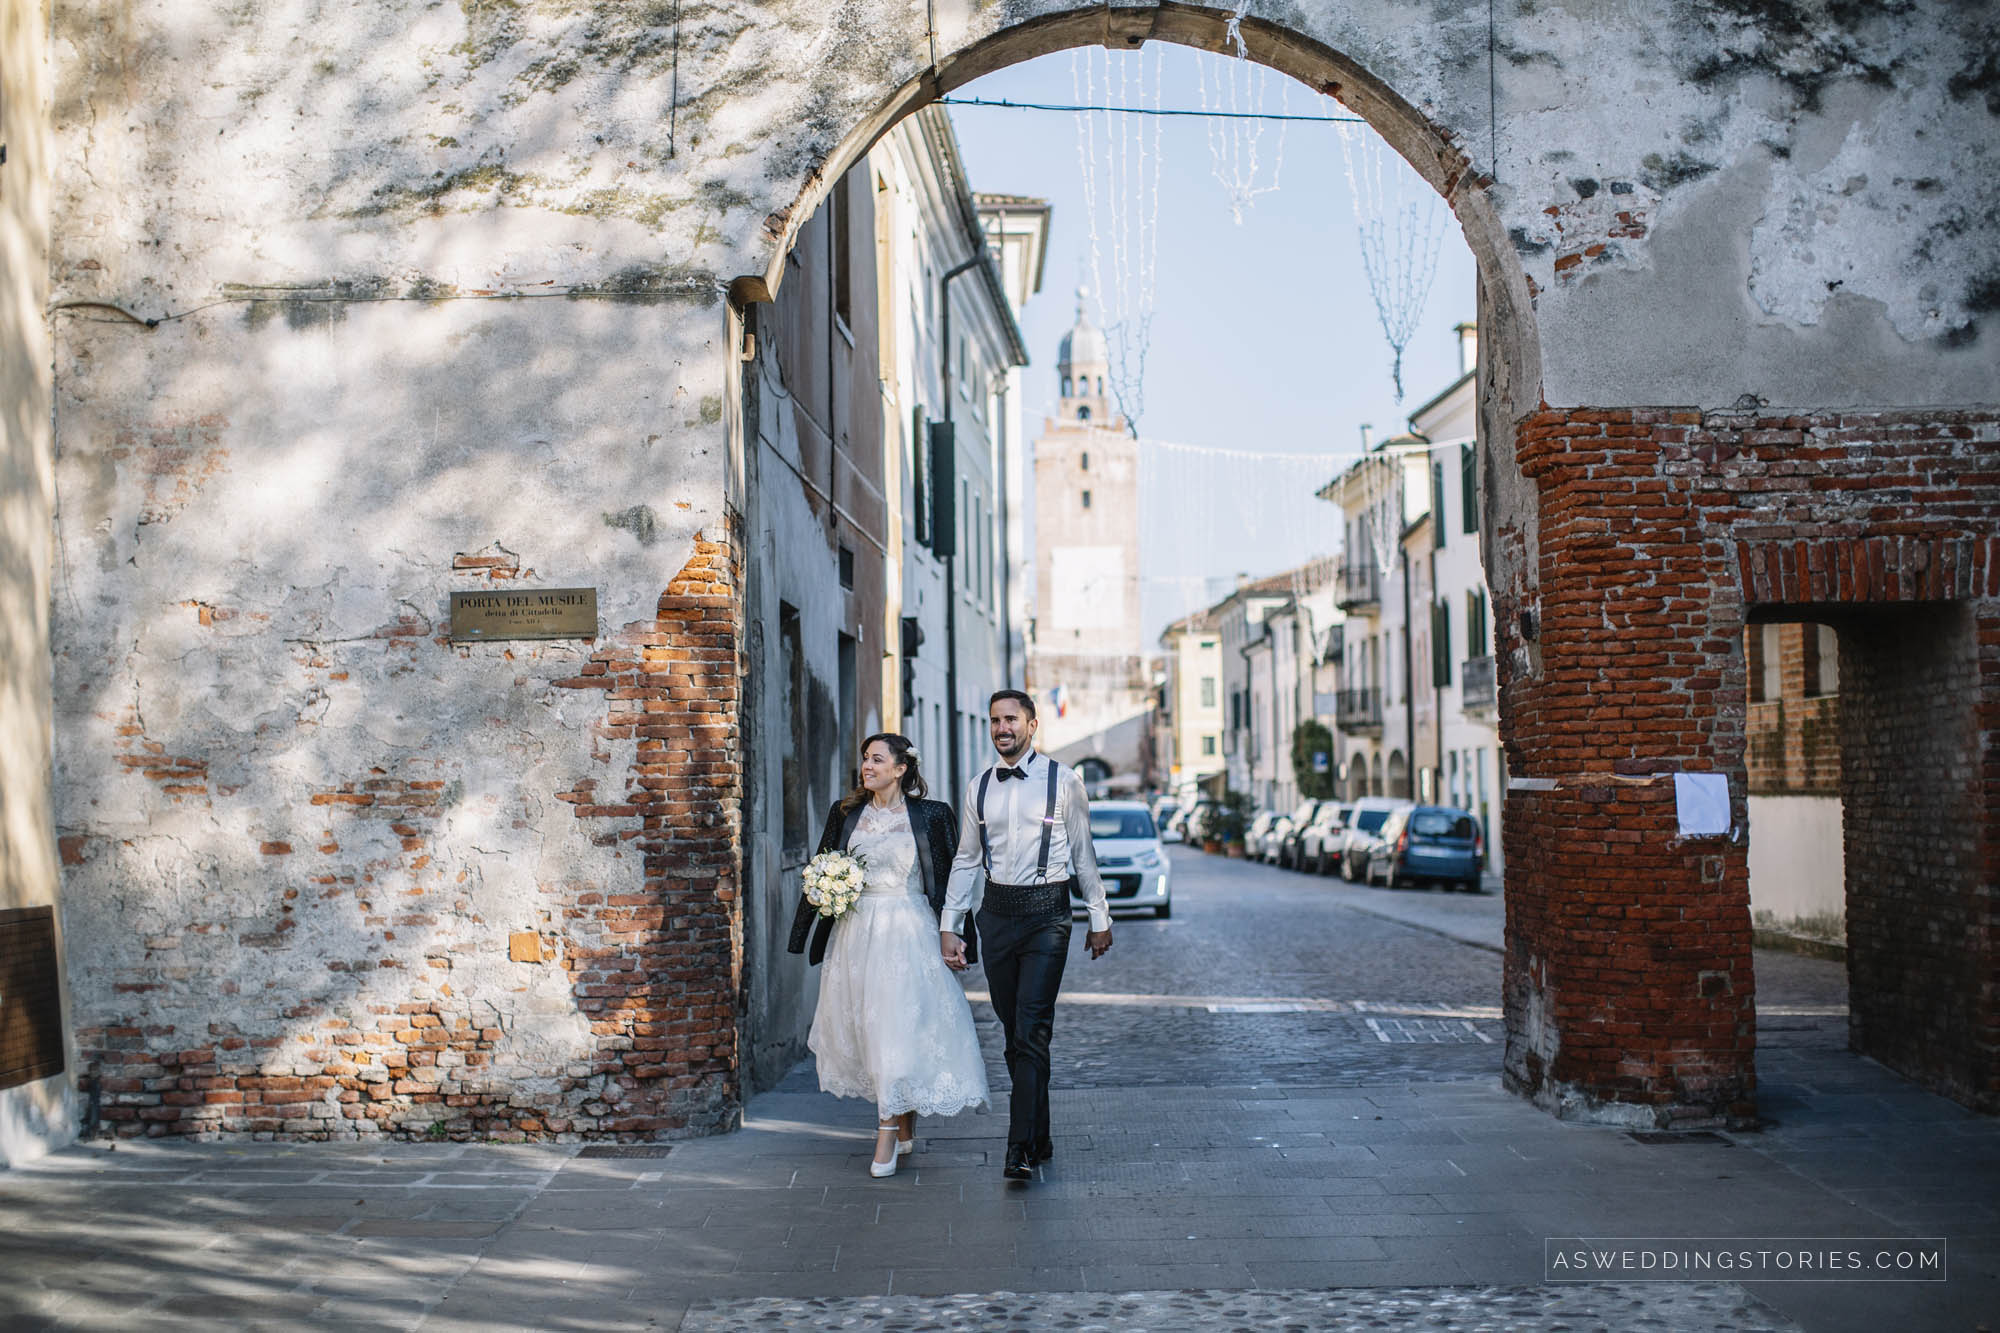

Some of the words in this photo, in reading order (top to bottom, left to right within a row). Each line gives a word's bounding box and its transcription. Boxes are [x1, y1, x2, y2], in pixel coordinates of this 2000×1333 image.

[460, 597, 501, 608] PORTA
[507, 596, 534, 607] DEL
[539, 594, 588, 606] MUSILE
